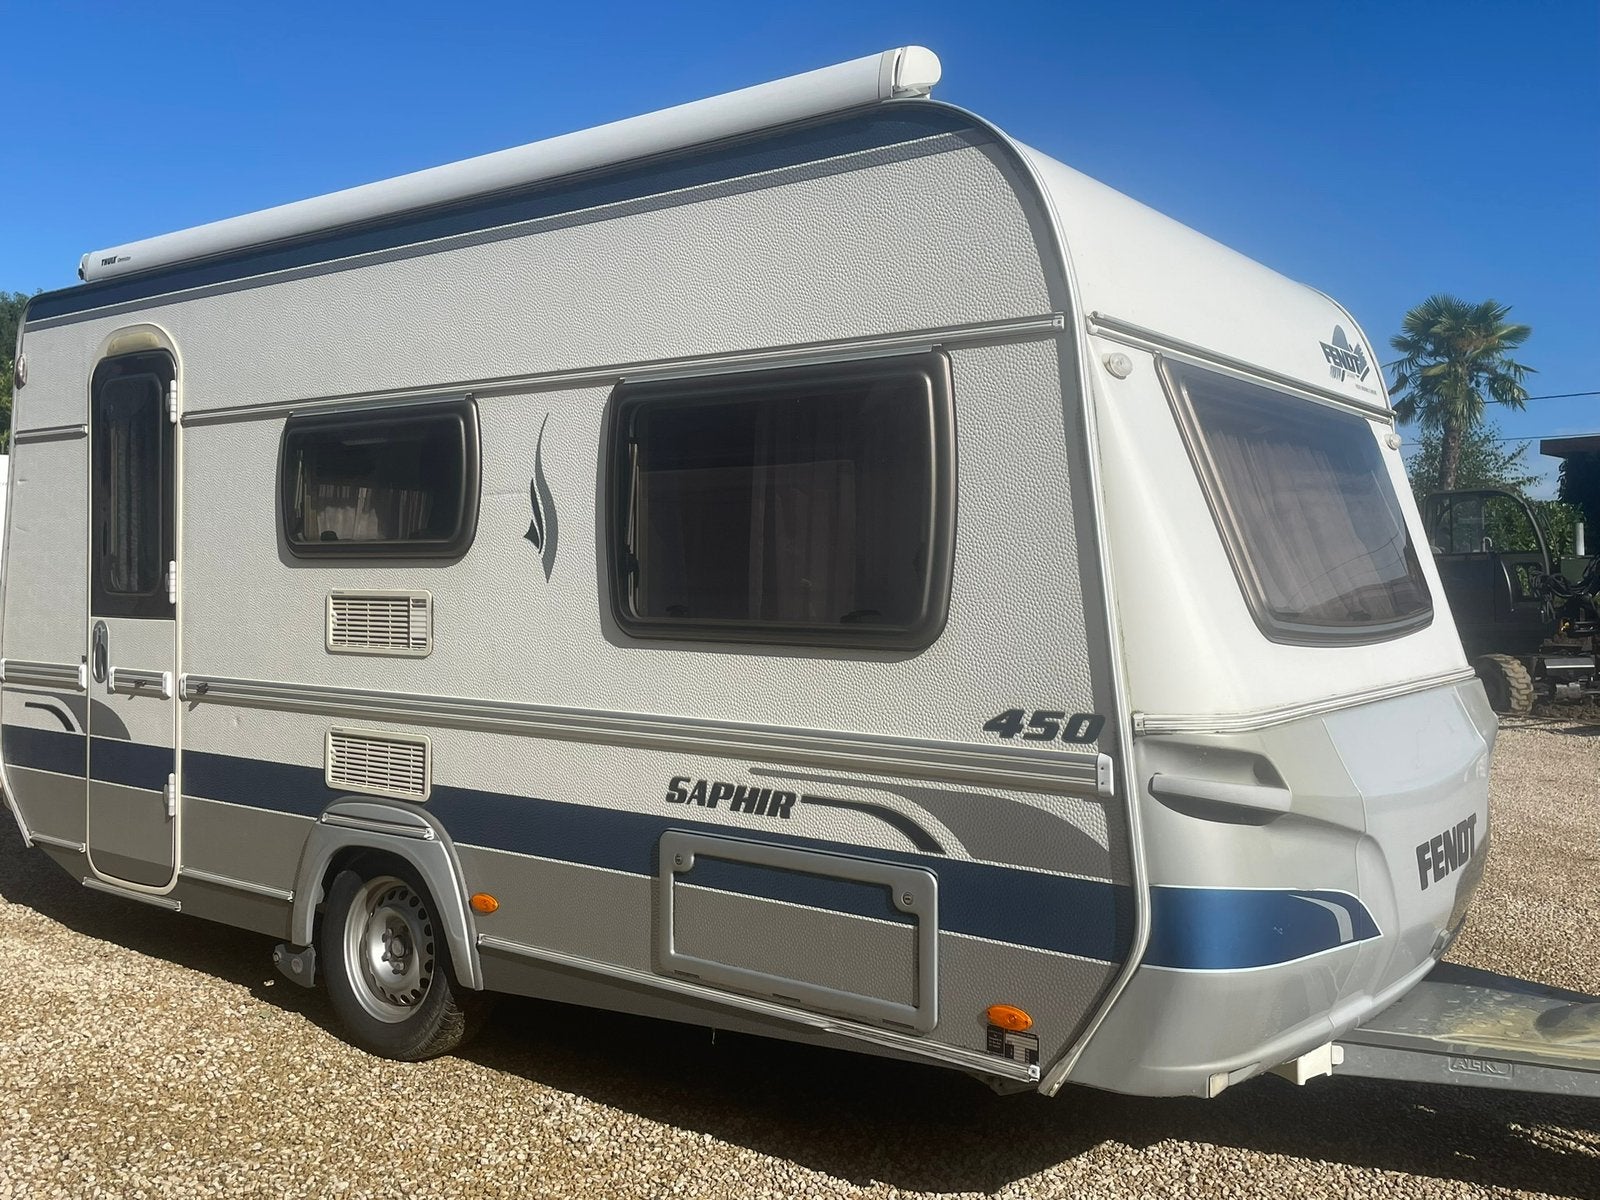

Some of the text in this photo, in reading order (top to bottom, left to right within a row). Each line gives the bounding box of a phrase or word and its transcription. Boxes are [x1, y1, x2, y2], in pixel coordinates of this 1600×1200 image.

[1319, 341, 1361, 375] FENDT
[982, 709, 1106, 744] 450
[665, 776, 797, 819] SAPHIR
[1416, 812, 1476, 891] FENDT
